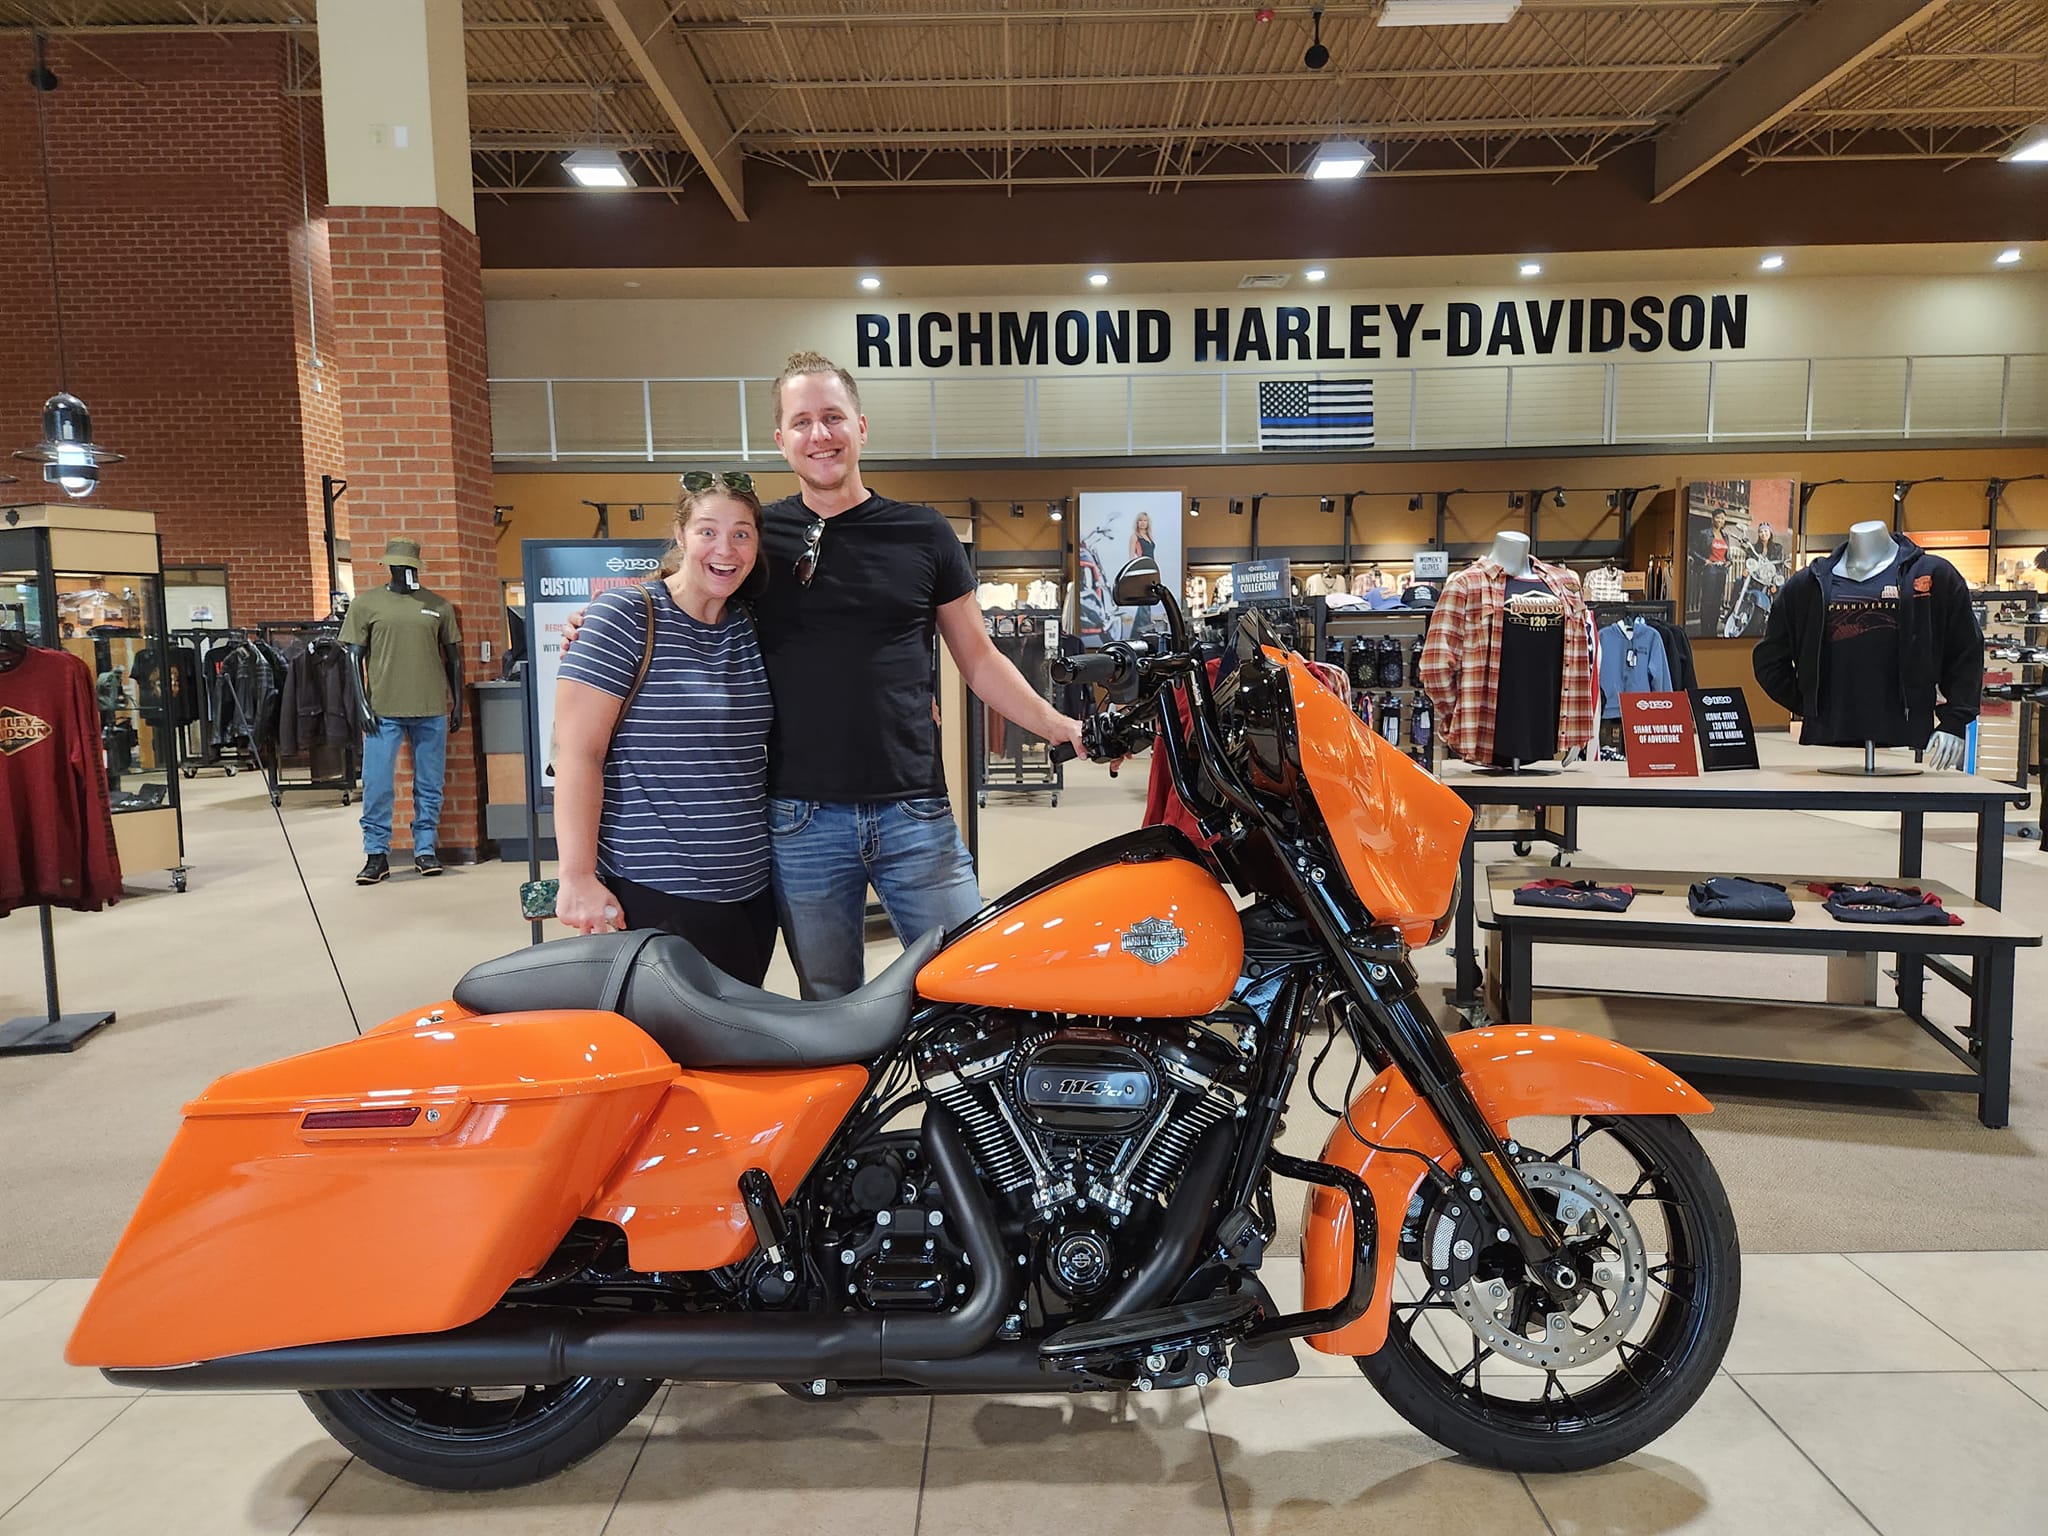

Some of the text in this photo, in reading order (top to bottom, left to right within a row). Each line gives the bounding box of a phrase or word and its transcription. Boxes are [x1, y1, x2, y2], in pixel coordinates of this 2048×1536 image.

[856, 294, 1748, 368] RICHMOND HARLEY-DAVIDSON
[1237, 571, 1280, 584] ANNIVERSARY
[540, 577, 589, 596] CUSTOM
[1240, 581, 1277, 594] COLLECTION
[1530, 616, 1547, 627] 120
[1633, 724, 1683, 734] SHARE YOUR LOVE
[1639, 734, 1680, 744] OF ADVENTURE
[1059, 1079, 1111, 1096] 114
